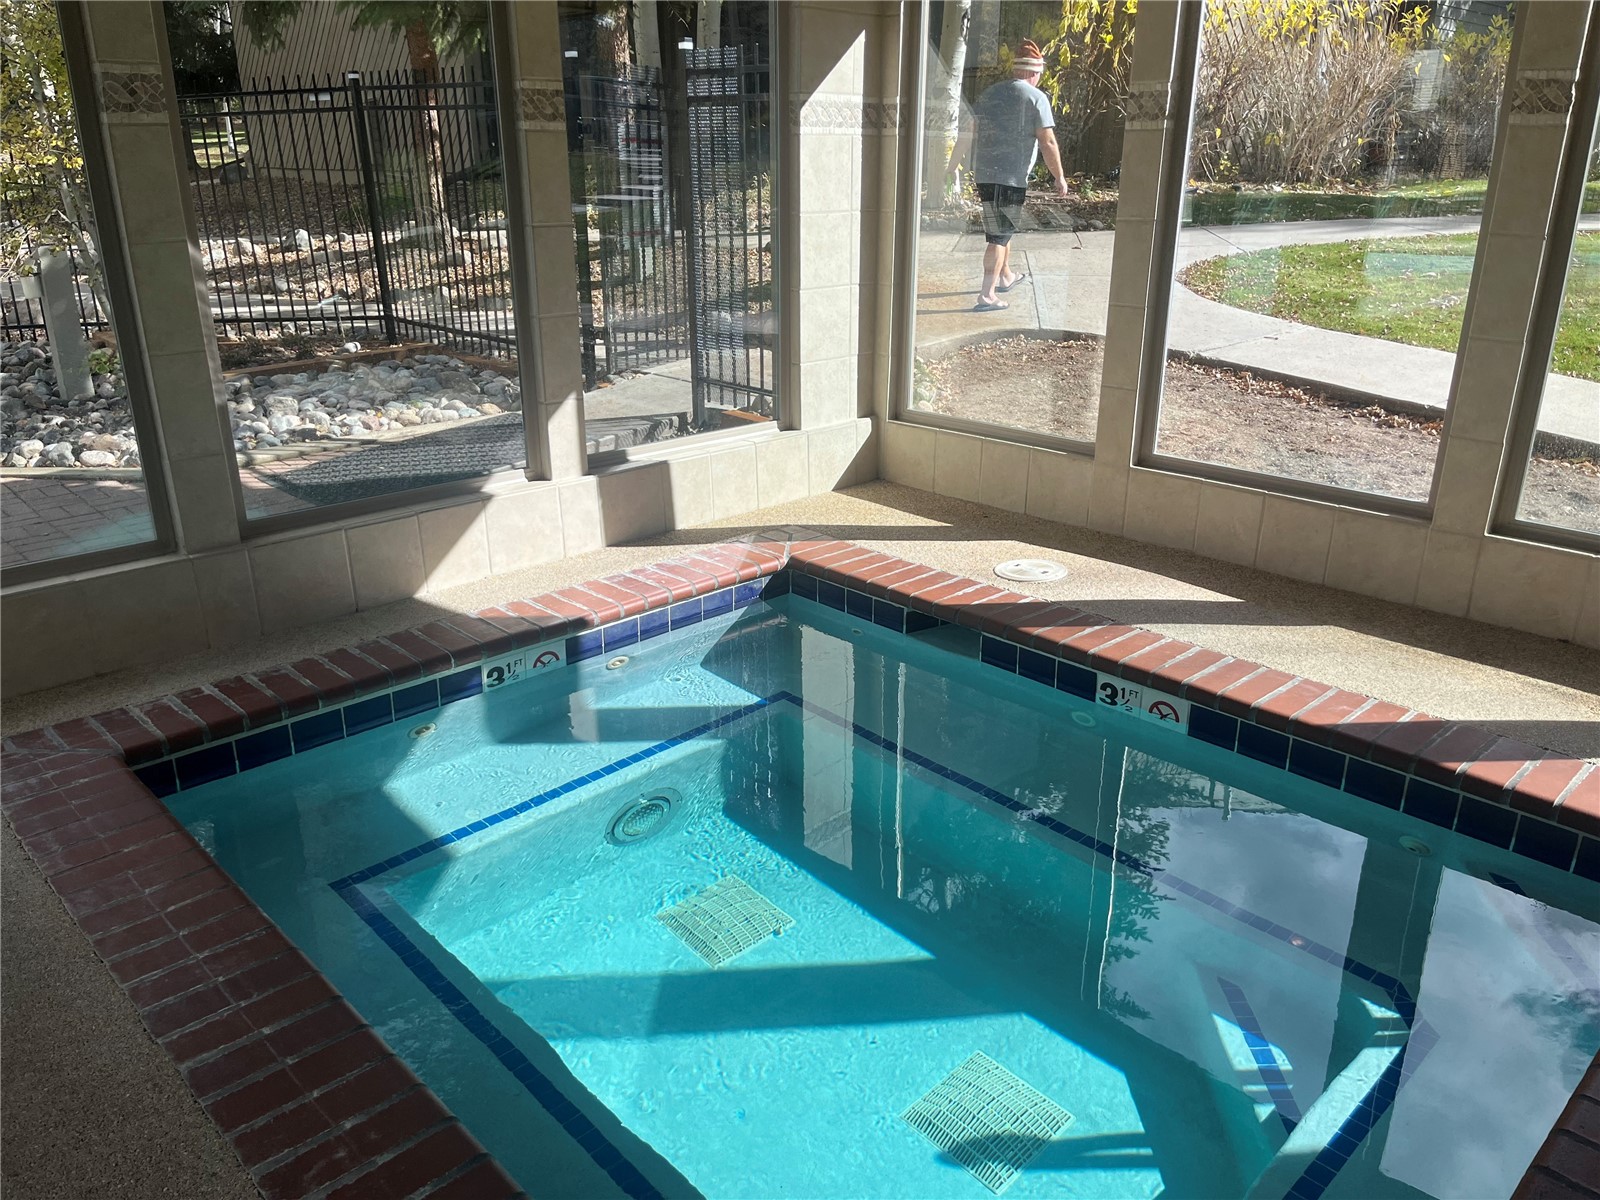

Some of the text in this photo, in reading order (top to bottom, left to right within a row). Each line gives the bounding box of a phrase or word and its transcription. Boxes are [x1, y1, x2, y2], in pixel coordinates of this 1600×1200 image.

[486, 666, 505, 688] 3
[514, 658, 523, 668] FT
[1099, 682, 1118, 706] 3
[1129, 689, 1140, 699] FT
